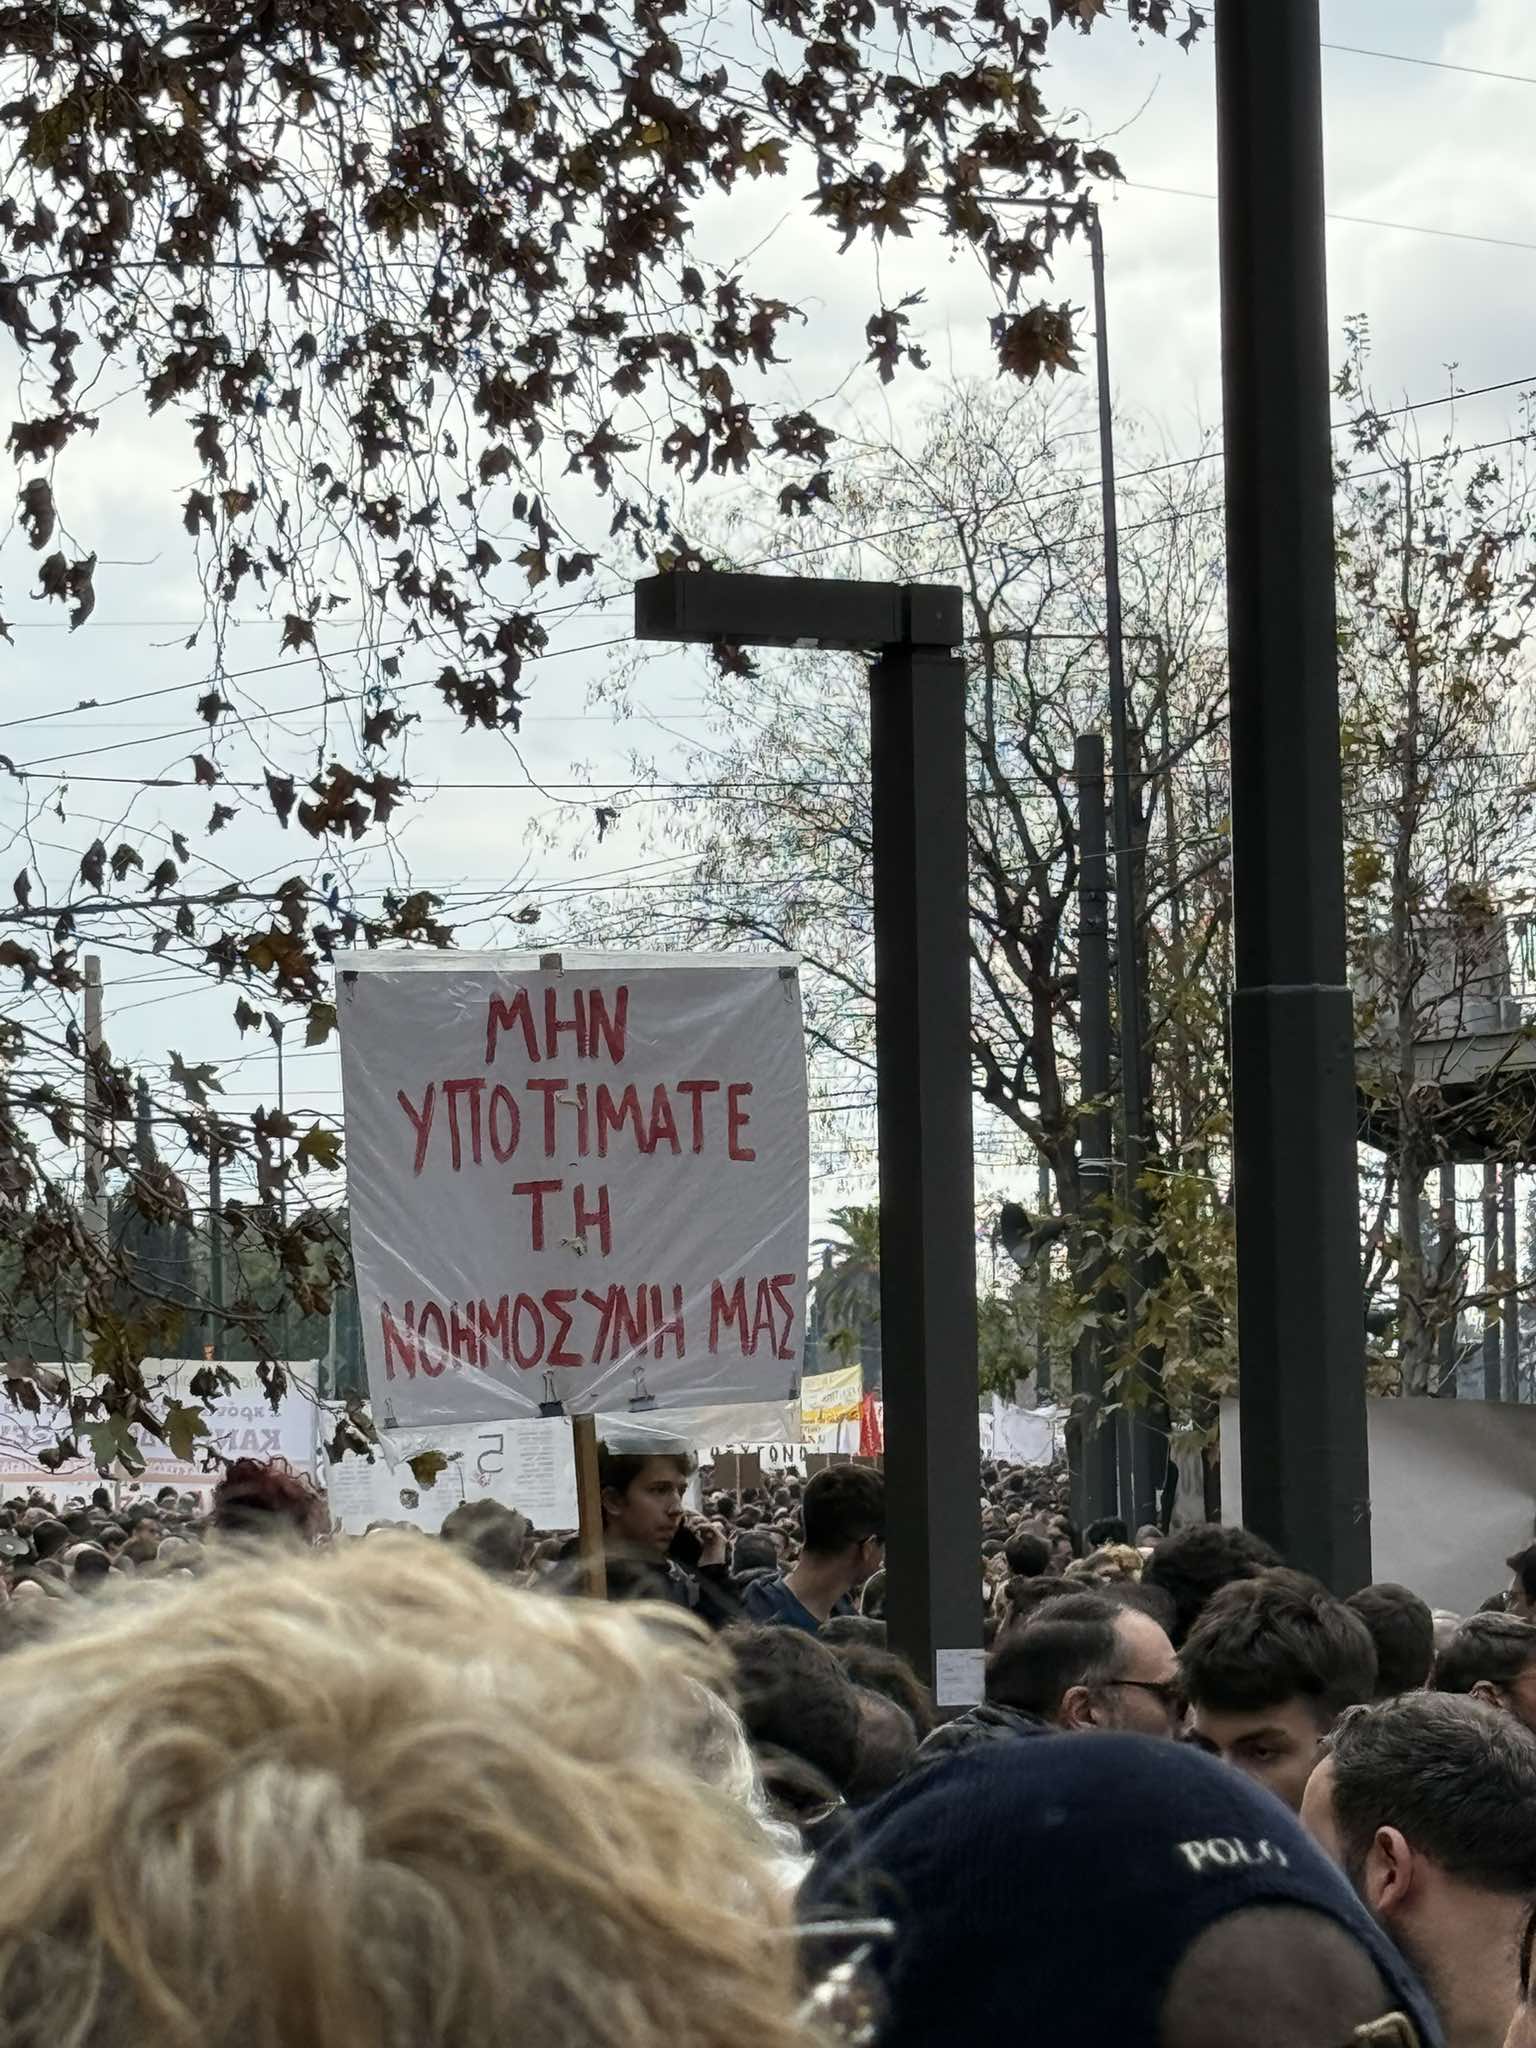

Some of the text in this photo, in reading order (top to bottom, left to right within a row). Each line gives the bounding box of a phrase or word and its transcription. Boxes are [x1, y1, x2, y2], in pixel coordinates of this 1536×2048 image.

[485, 985, 629, 1065] ΜΗΝ
[397, 1078, 757, 1176] ΥΠΟΤΙΜΑΤΕ
[512, 1179, 613, 1257] ΤΗ
[380, 1273, 797, 1381] ΝΟΗΜΟΣΥΝΗ ΜΑΣ
[1178, 1837, 1289, 1870] POLO
